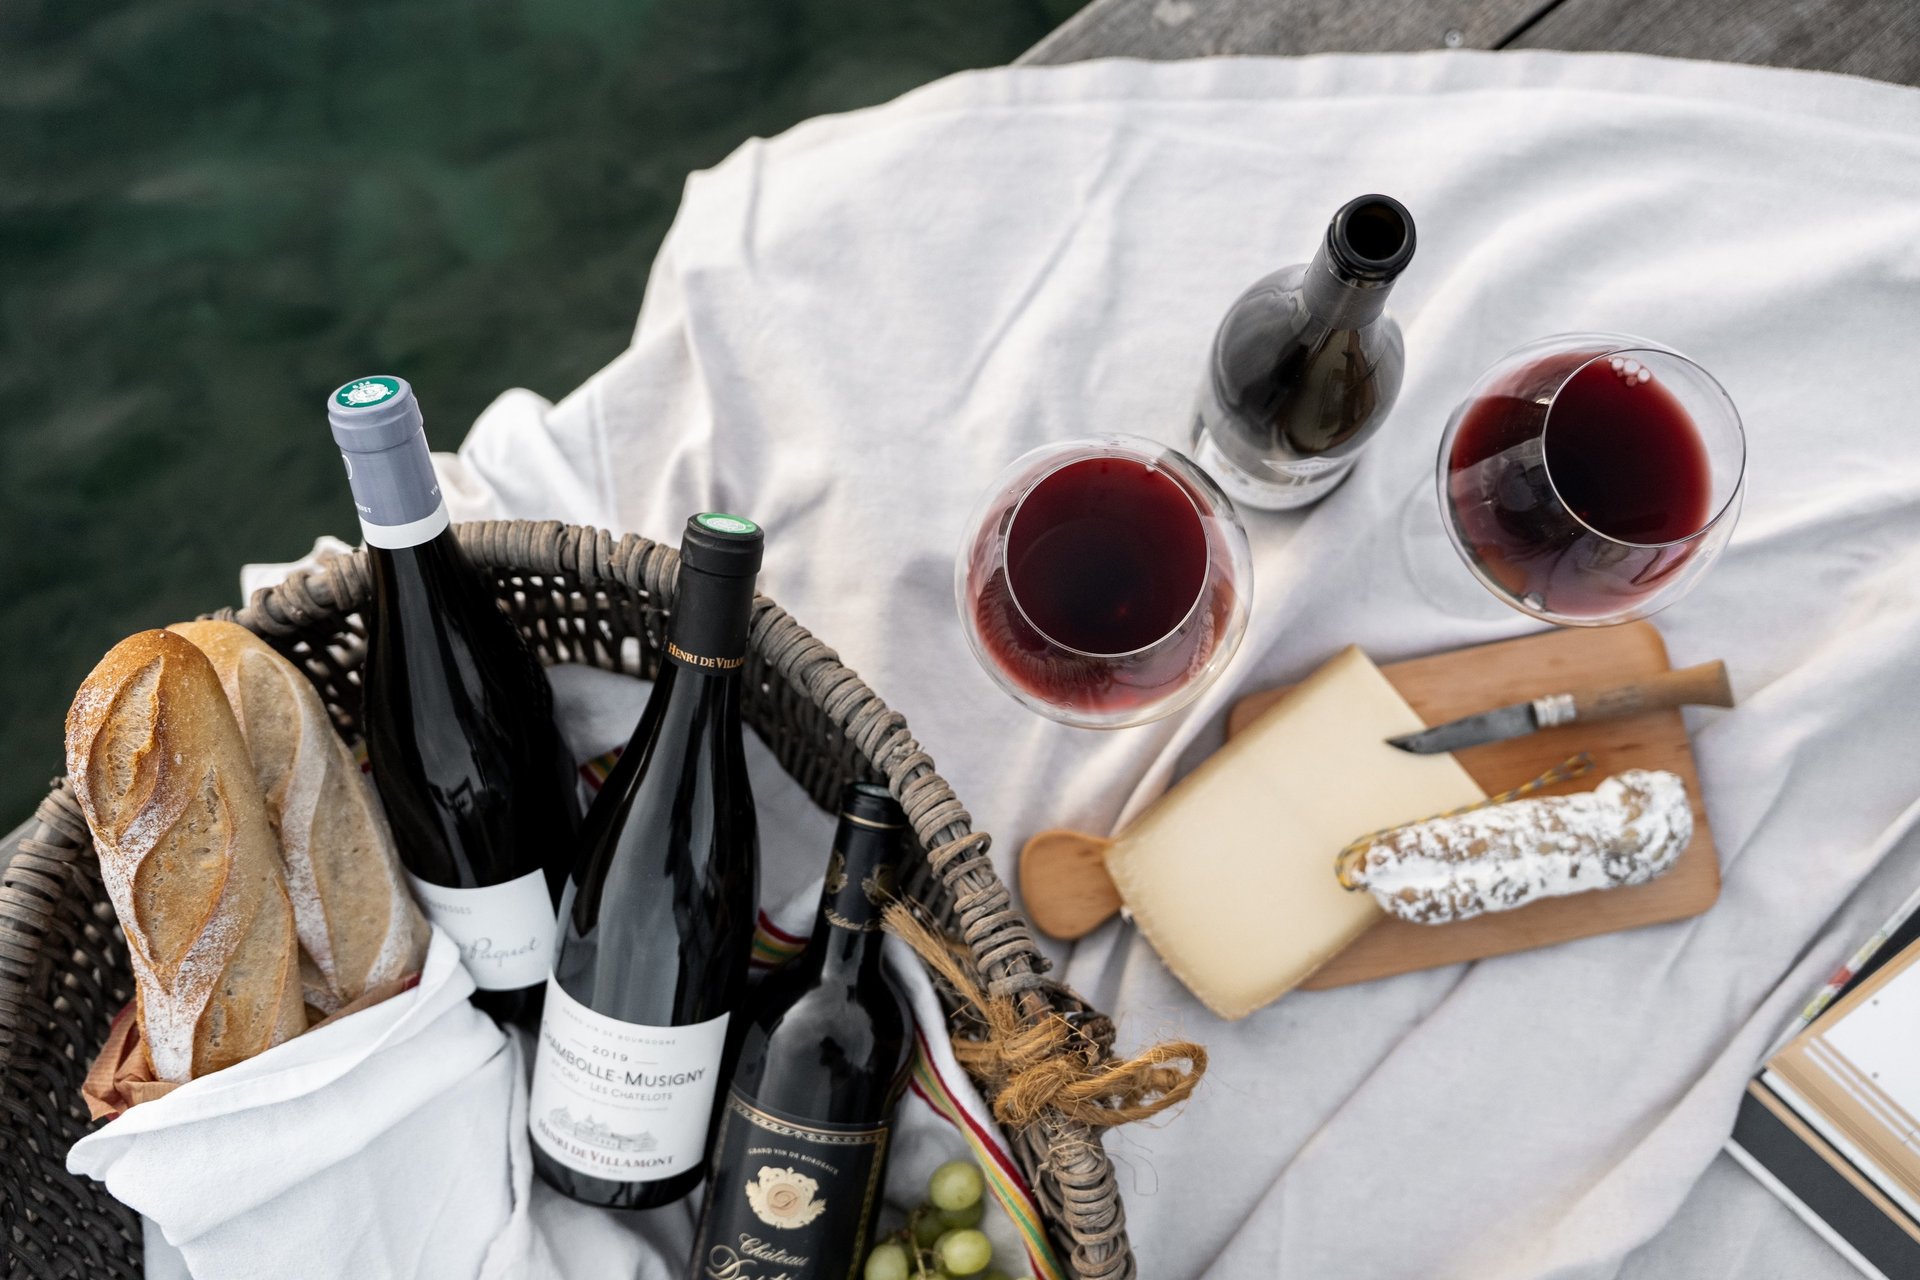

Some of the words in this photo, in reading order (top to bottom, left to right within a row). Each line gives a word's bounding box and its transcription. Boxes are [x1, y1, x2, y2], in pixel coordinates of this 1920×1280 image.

[667, 641, 699, 665] HENRI
[699, 656, 715, 668] DE
[592, 1044, 629, 1062] 2019
[589, 1081, 608, 1095] LES
[610, 1088, 673, 1102] CHATELOTS
[537, 1117, 569, 1151] HENRI
[570, 1144, 587, 1159] DE
[589, 1149, 675, 1169] VILLAMONT
[746, 1147, 773, 1157] GRAND
[800, 1154, 839, 1176] BORDEAUX
